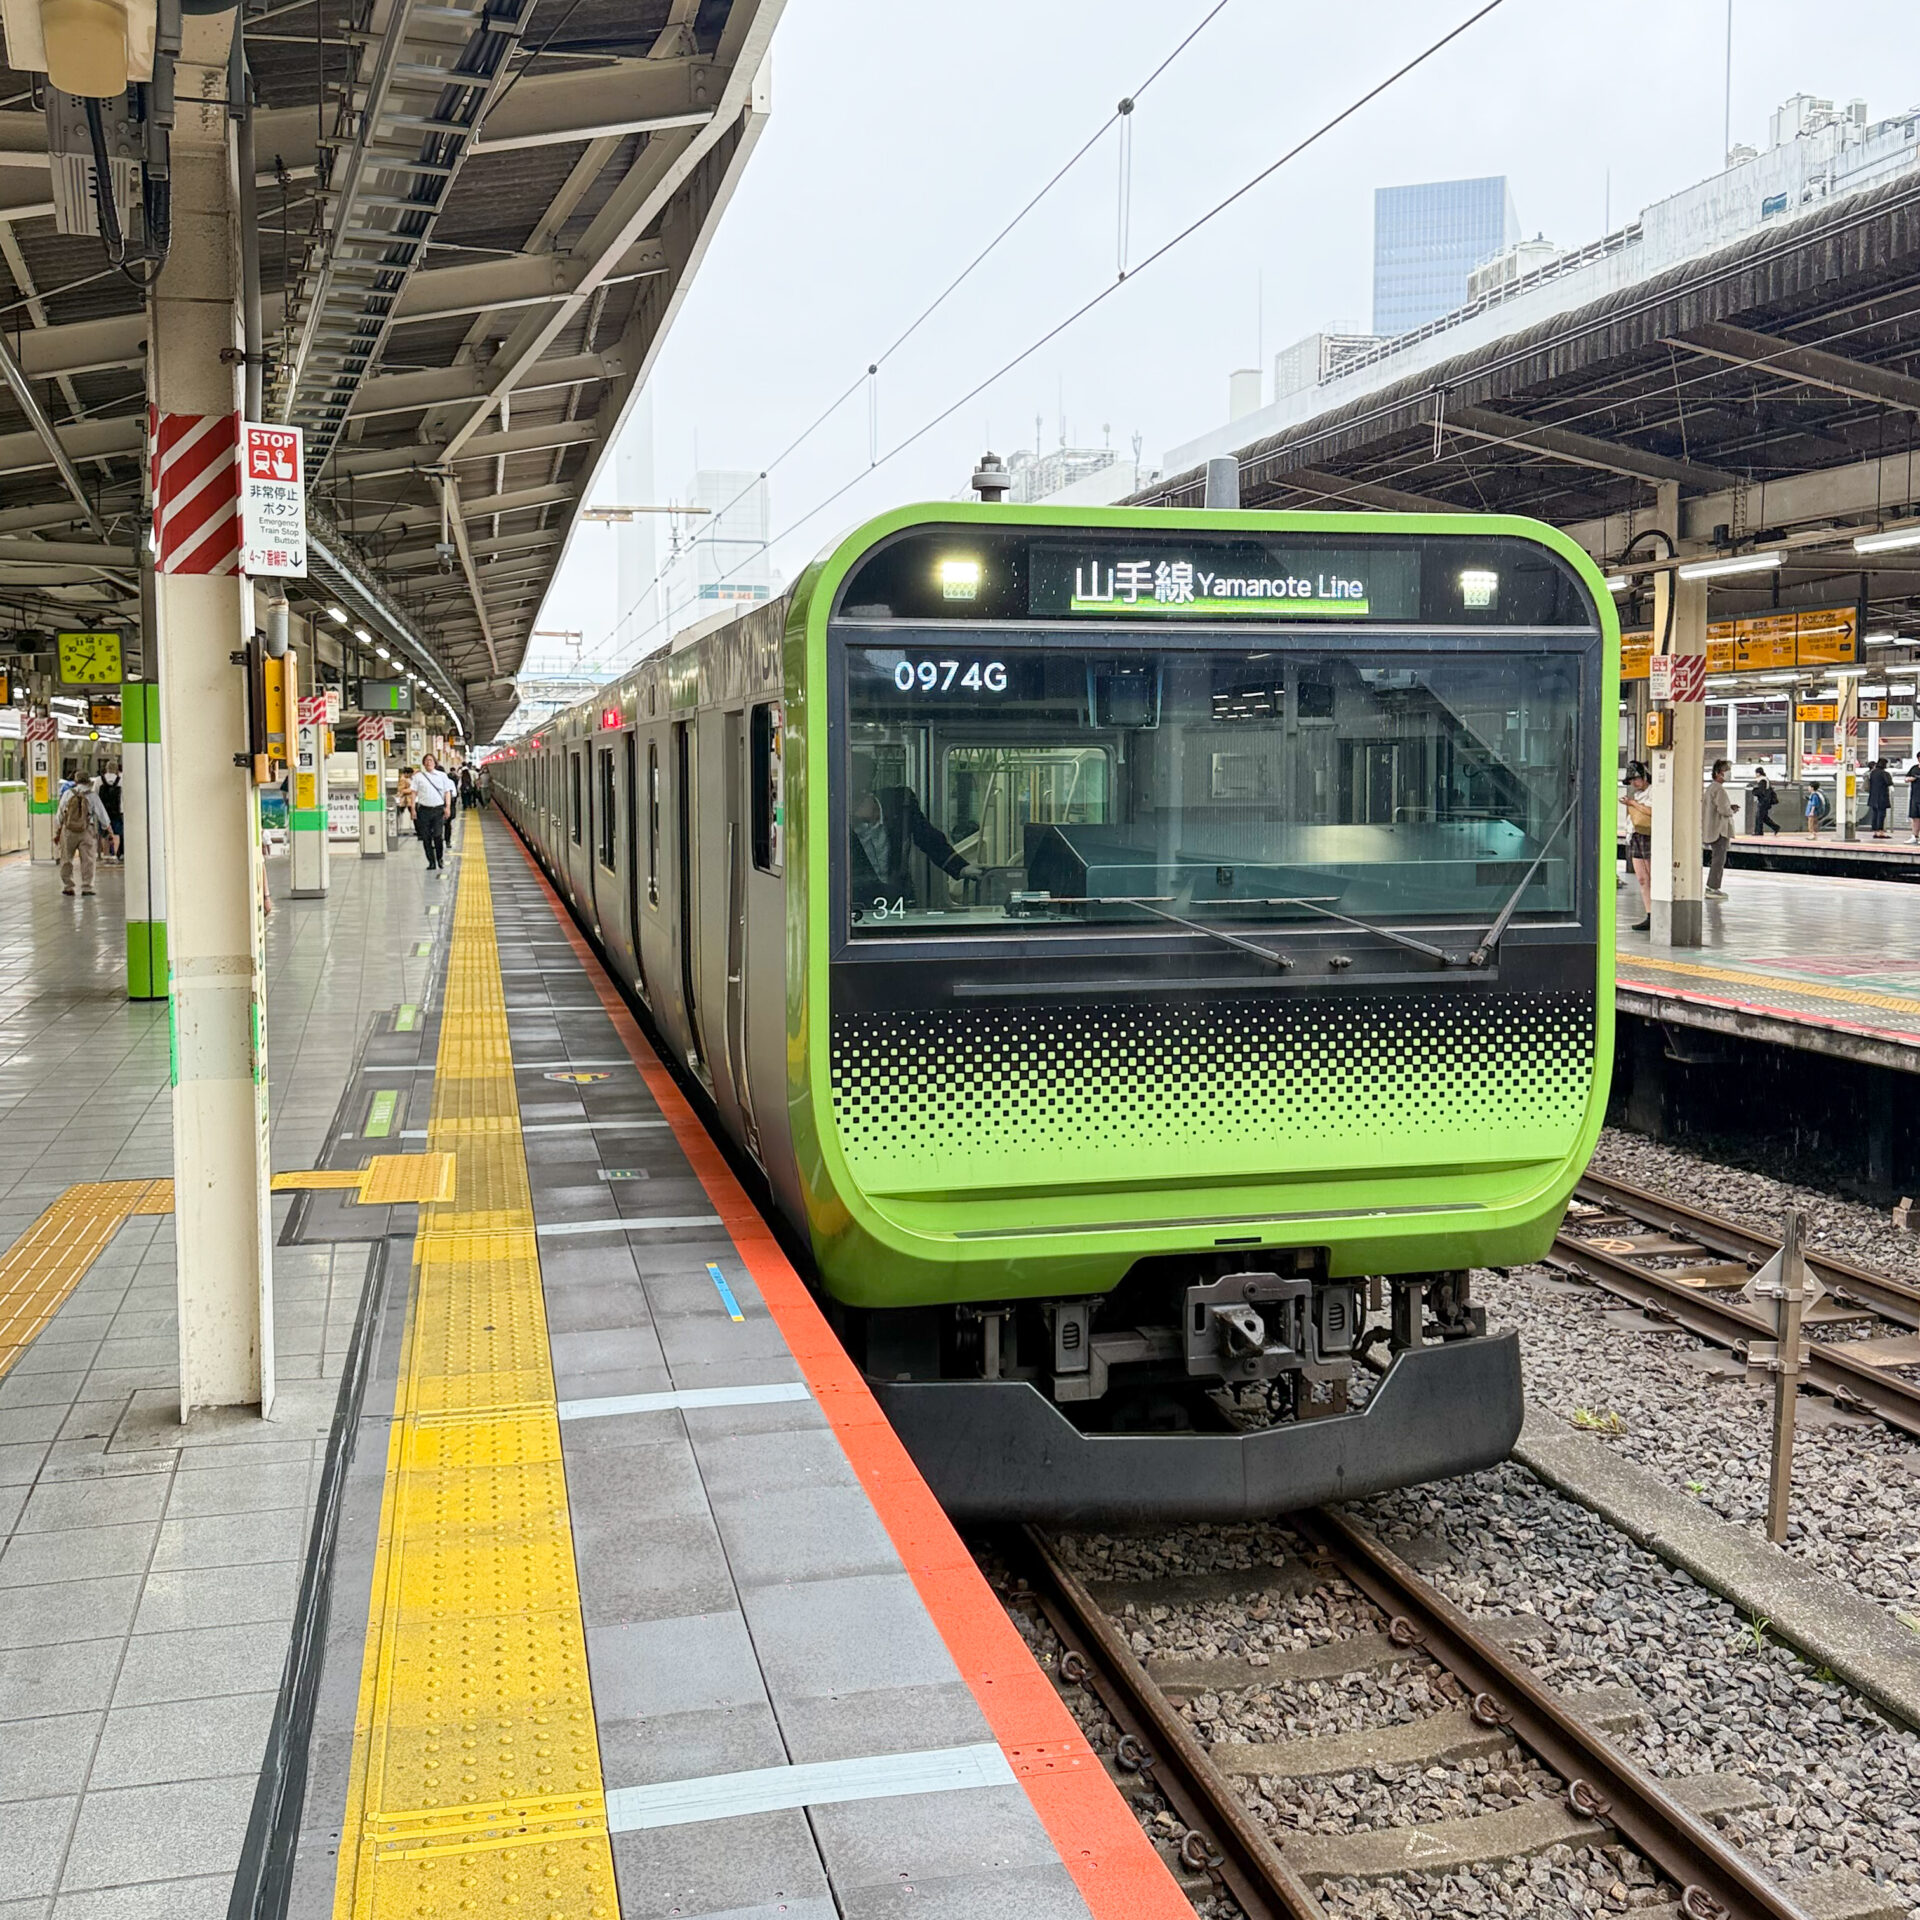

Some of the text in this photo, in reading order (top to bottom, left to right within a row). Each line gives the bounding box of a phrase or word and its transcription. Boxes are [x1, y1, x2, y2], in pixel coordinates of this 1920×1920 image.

[250, 431, 294, 449] STOP
[250, 485, 299, 501] 非常停止
[263, 503, 299, 516] ボタン
[259, 517, 299, 528] Emergency
[260, 525, 299, 537] Train Stop
[274, 535, 300, 545] Button
[1076, 561, 1363, 604] 山手線 Yamanote Line
[894, 661, 1008, 691] 0974G
[399, 686, 408, 699] 5
[328, 793, 350, 801] Make
[872, 896, 907, 920] 34
